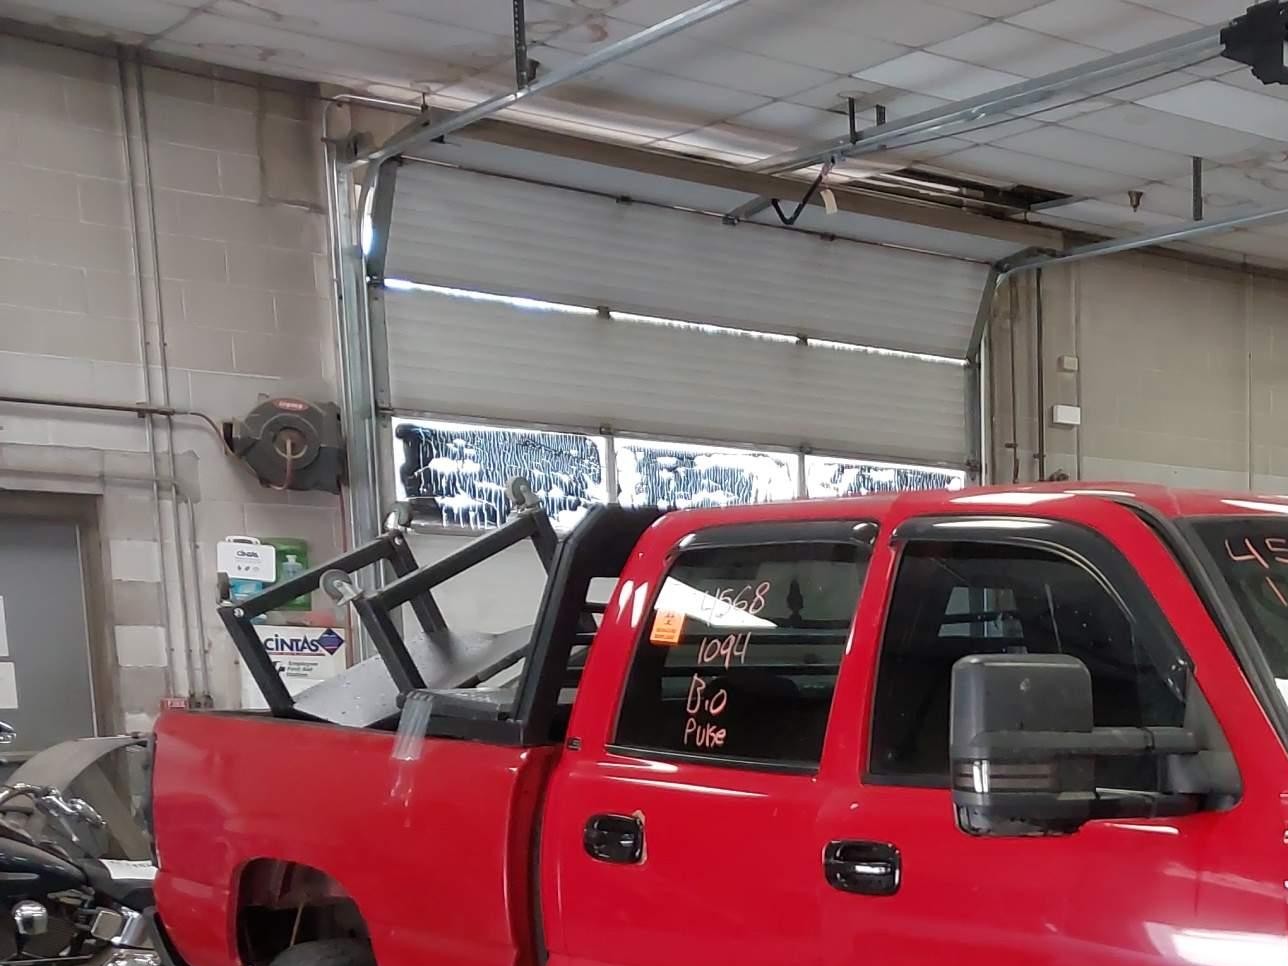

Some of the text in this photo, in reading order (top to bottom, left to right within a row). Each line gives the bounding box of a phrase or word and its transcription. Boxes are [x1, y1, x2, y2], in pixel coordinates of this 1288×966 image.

[699, 581, 771, 627] 4568
[264, 634, 320, 652] CINTAS
[697, 631, 752, 670] 1094
